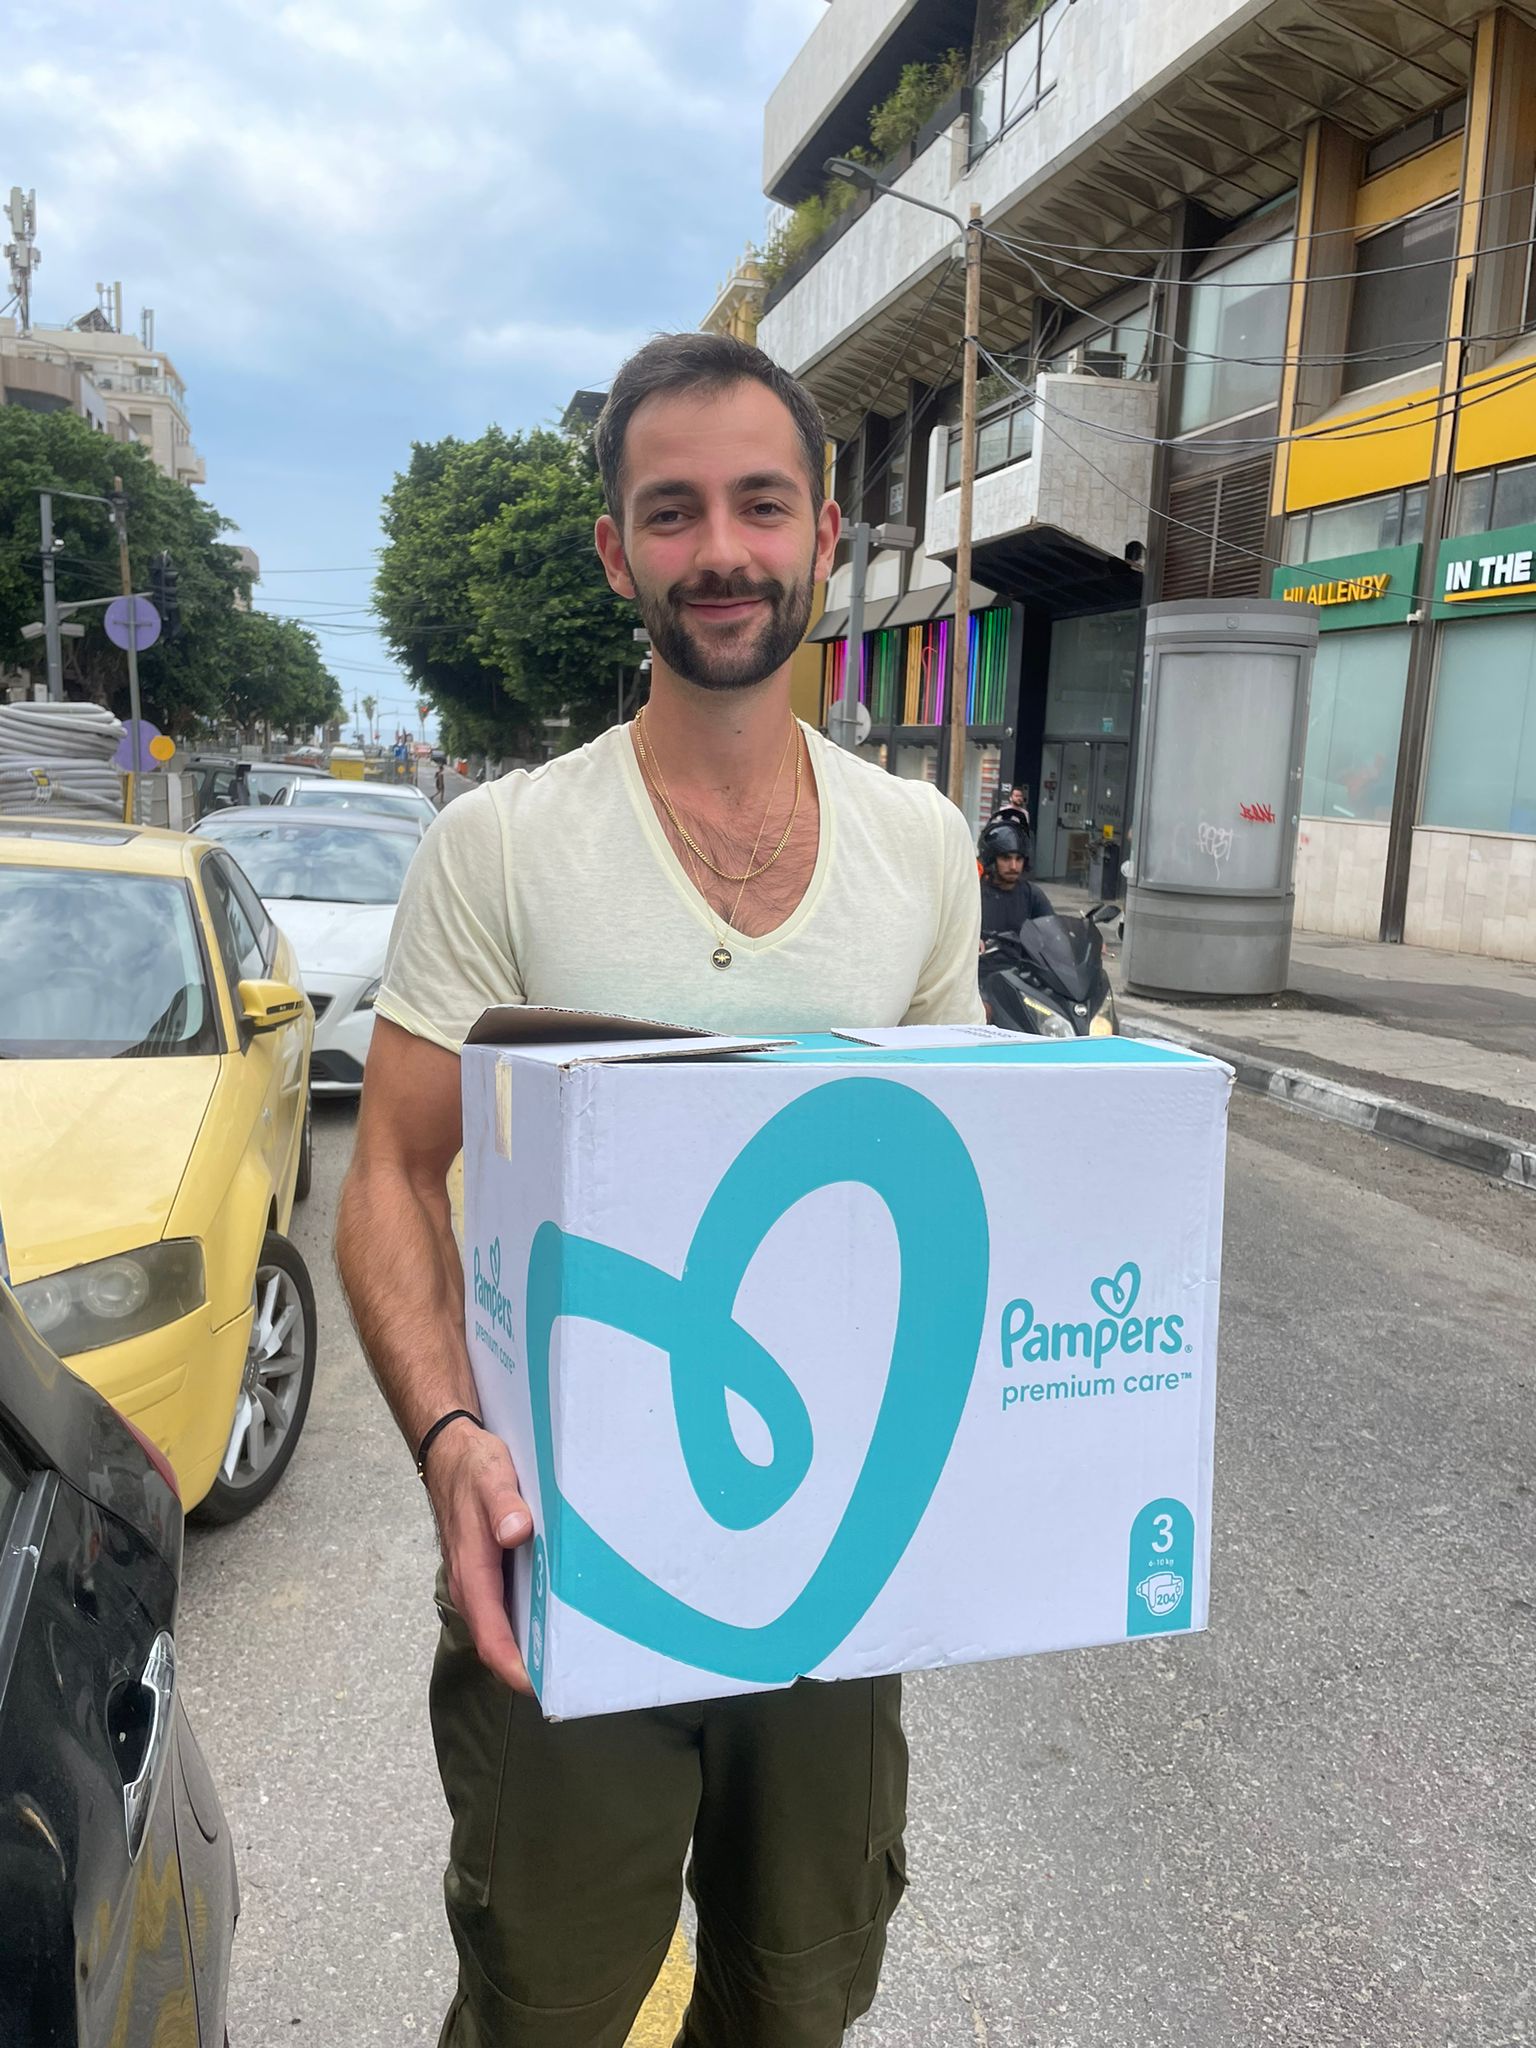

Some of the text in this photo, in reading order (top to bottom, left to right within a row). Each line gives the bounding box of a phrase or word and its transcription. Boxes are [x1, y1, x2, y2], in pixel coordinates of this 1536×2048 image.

[1307, 573, 1388, 605] ALLENBY
[1445, 550, 1533, 591] IN THE
[474, 1246, 514, 1341] Pampers
[1002, 1374, 1115, 1411] premium
[1151, 1513, 1174, 1553] 3
[536, 1553, 543, 1598] 3
[1157, 1593, 1176, 1606] 204
